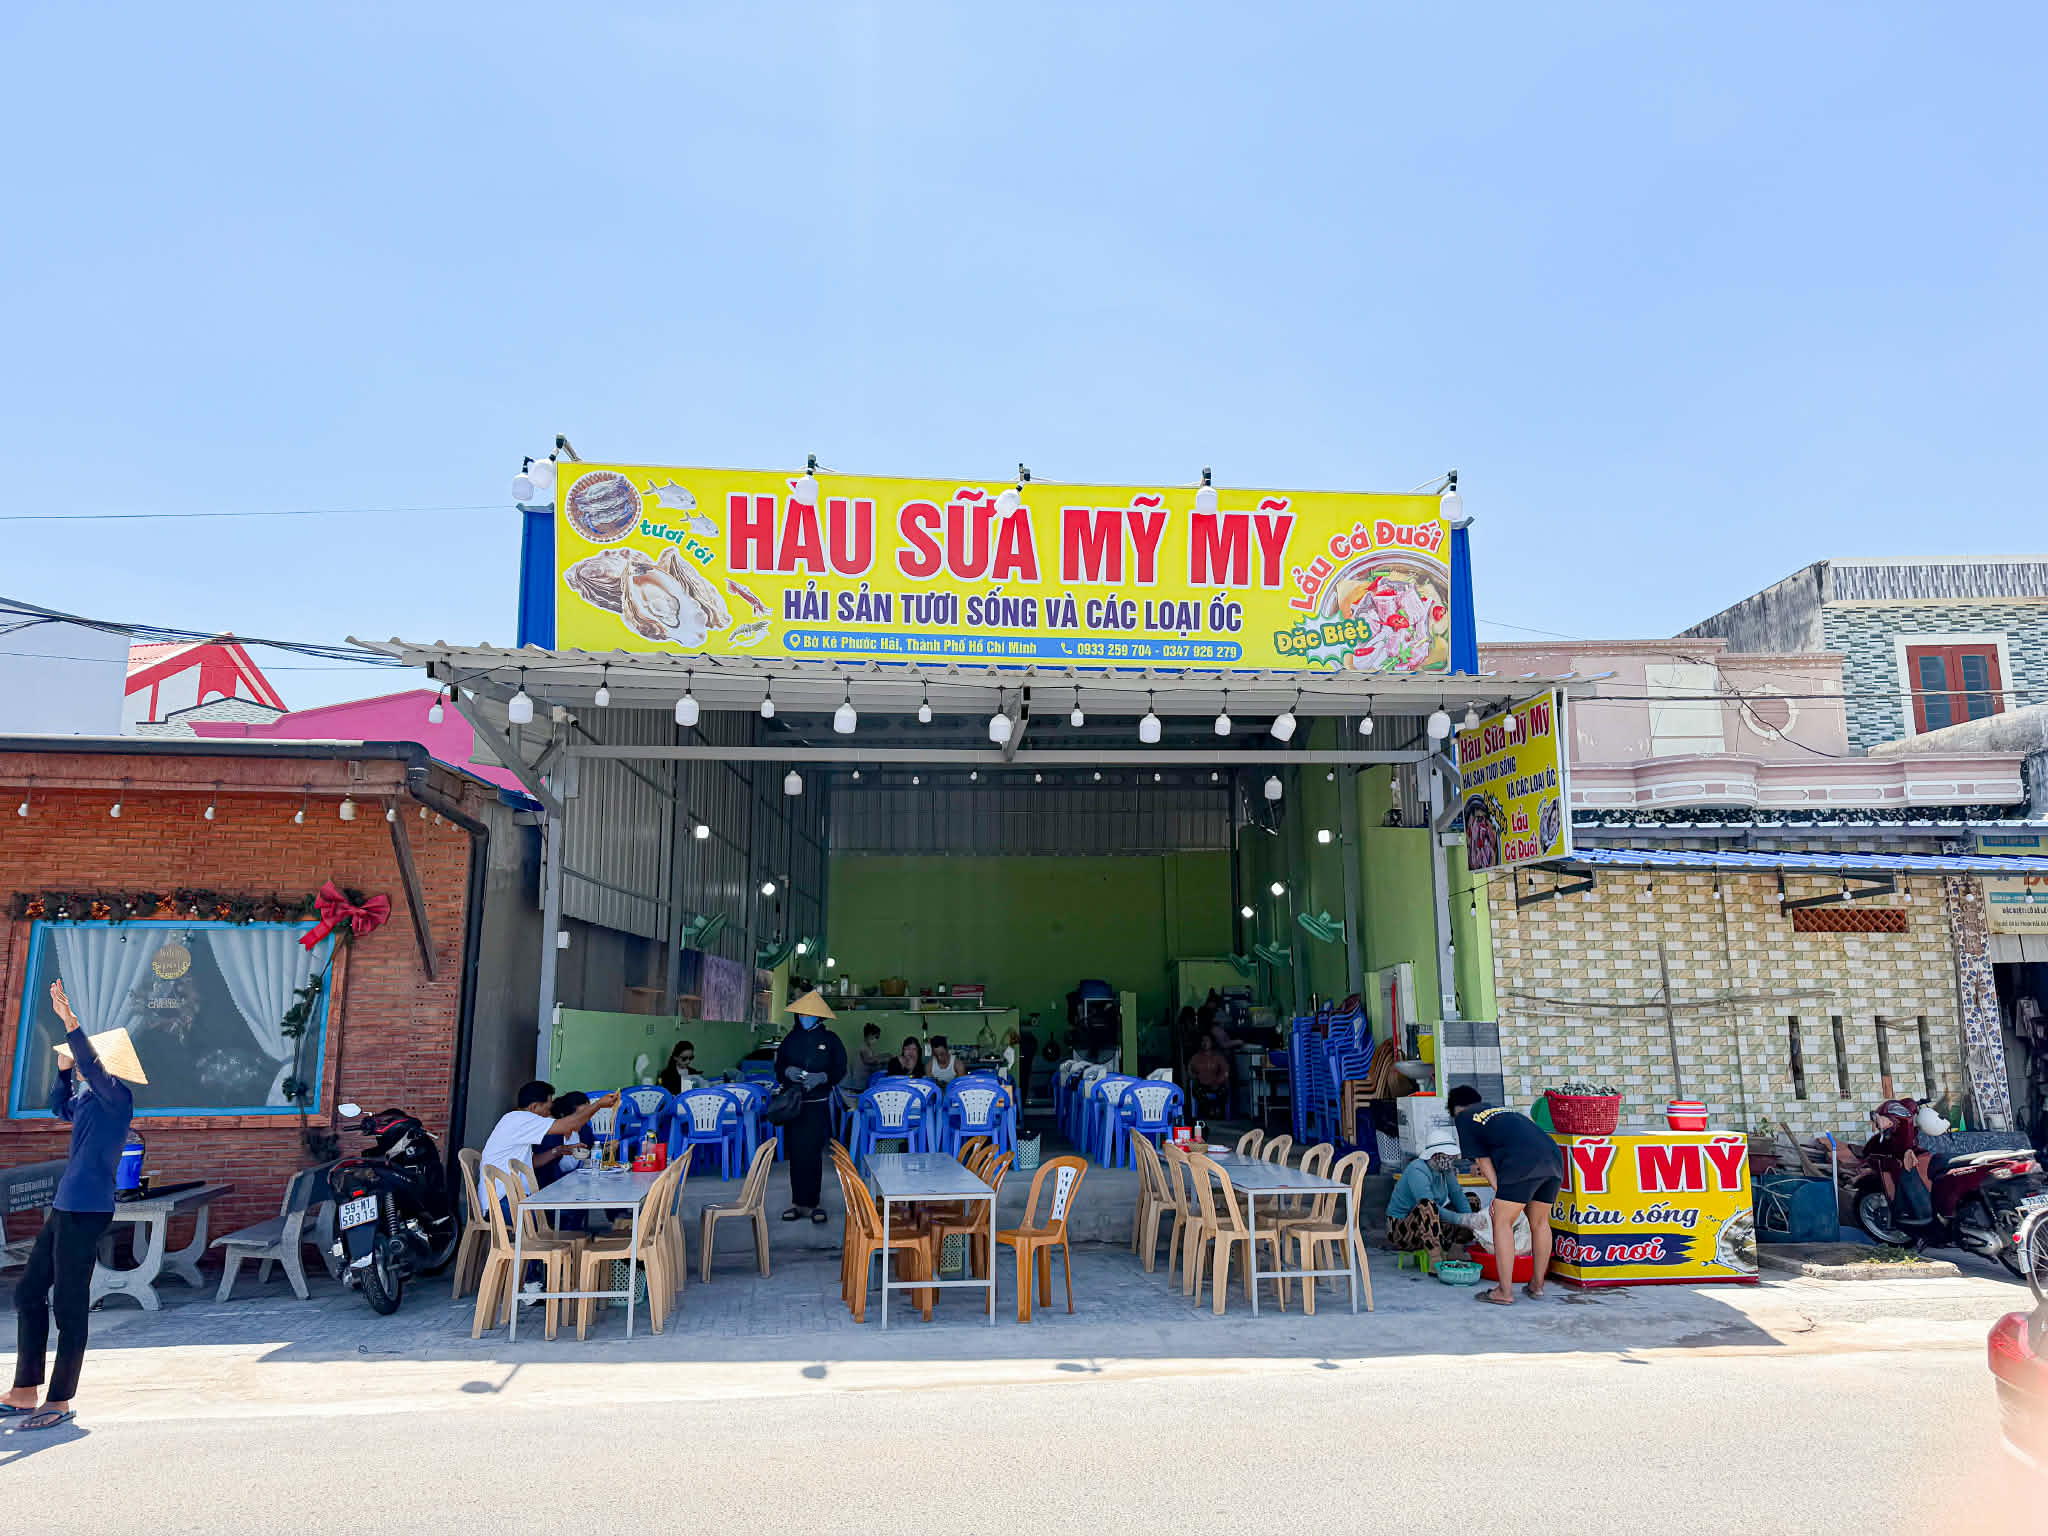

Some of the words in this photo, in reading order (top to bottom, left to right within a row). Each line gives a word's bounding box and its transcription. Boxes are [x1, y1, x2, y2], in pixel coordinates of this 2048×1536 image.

[640, 519, 686, 545] tươi
[686, 539, 715, 565] rói
[898, 490, 1039, 580] SỮA
[1063, 496, 1168, 583] MỸ
[1190, 499, 1294, 586] MỸ
[1290, 557, 1332, 610] Lẩu
[1330, 523, 1370, 559] Cá
[1376, 521, 1443, 552] Đuối
[784, 580, 829, 620] HẢI
[838, 582, 892, 623] SẢN
[901, 592, 957, 625] TƯƠI
[967, 586, 1037, 628] SỐNG
[1046, 592, 1077, 628] VÀ
[1087, 594, 1136, 631] CÁC
[1146, 601, 1200, 637] LOẠI
[1210, 592, 1241, 632] ỐC
[906, 638, 940, 651] Thành
[1009, 641, 1037, 654] Minh
[1077, 643, 1104, 655] 0933
[1108, 644, 1128, 656] 259
[1132, 645, 1151, 656] 704
[1163, 646, 1189, 657] 0347
[1217, 647, 1237, 659] 279
[1277, 629, 1319, 654] Đặc
[1323, 620, 1369, 645] Biệt
[1484, 724, 1506, 755] Sữa
[1530, 702, 1550, 737] Mỹ
[1505, 839, 1516, 860] Cá
[1561, 1138, 1613, 1191] Ỹ
[1638, 1137, 1746, 1191] MỸ
[1570, 1204, 1625, 1223] hàu
[1632, 1201, 1699, 1227] sống
[1556, 1236, 1599, 1263] tận
[1606, 1238, 1666, 1260] nơi
